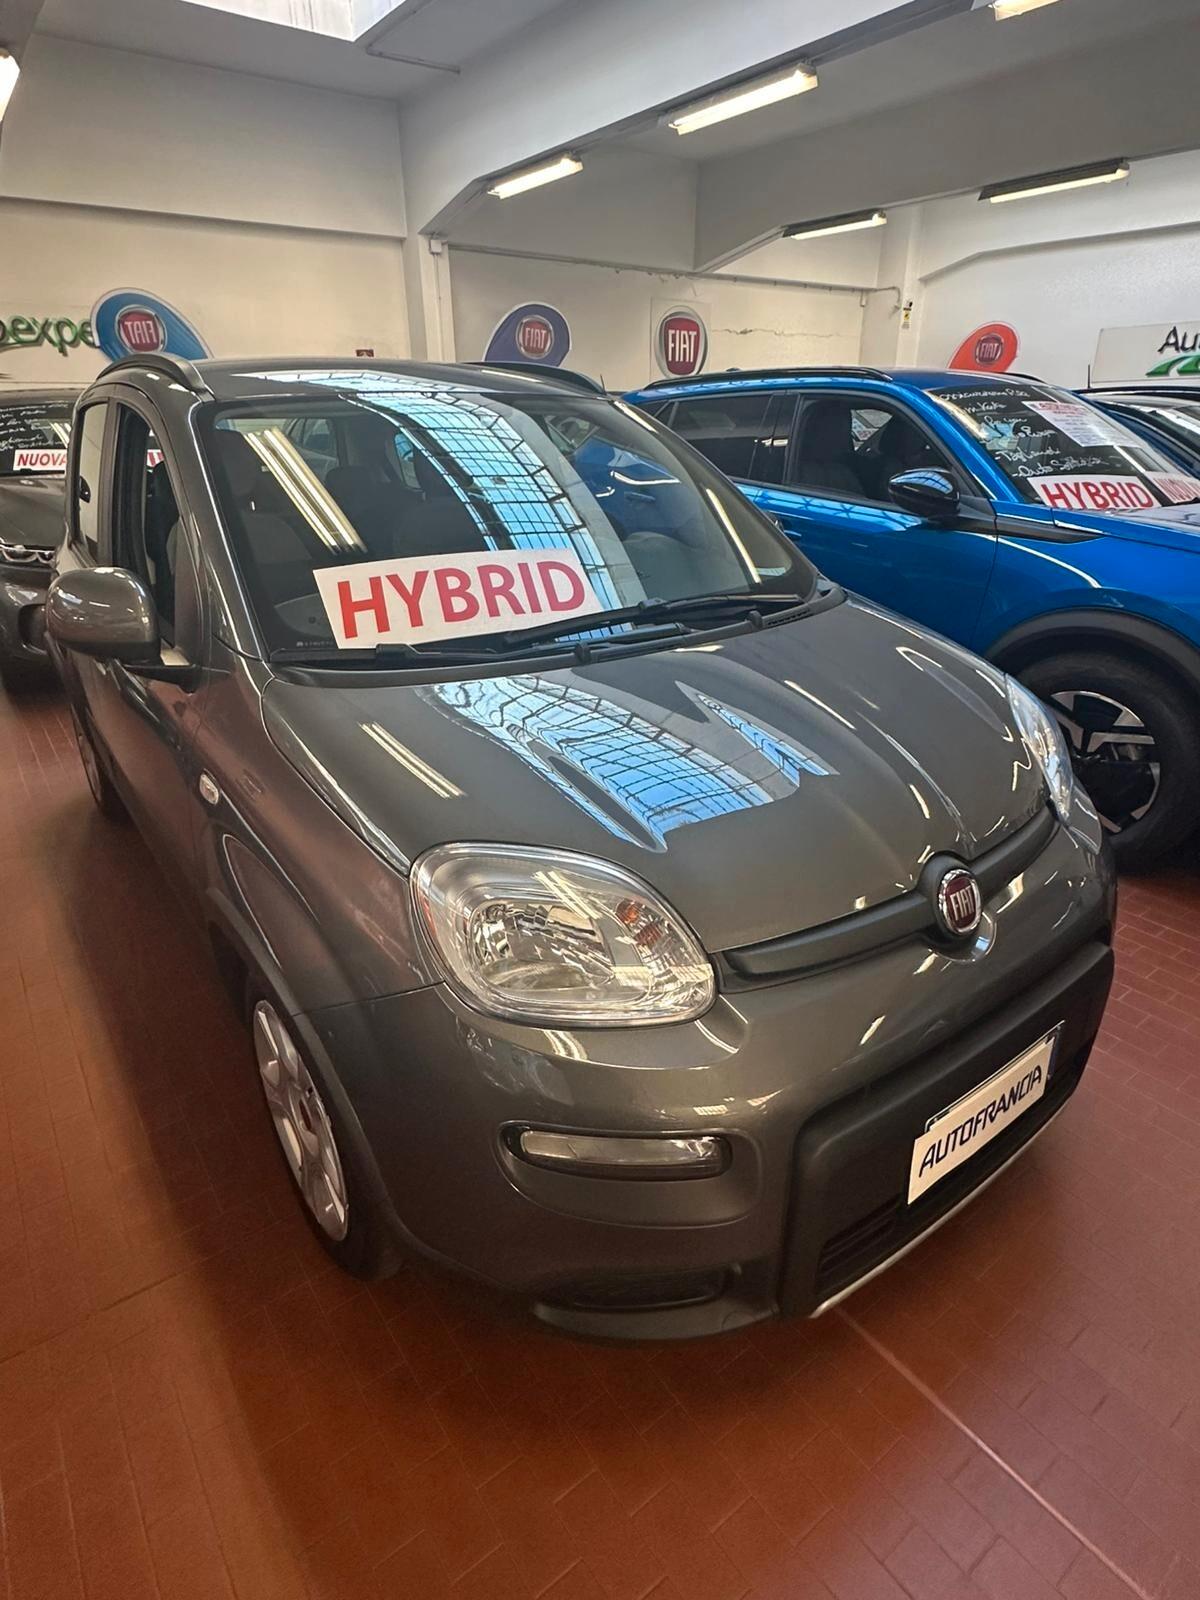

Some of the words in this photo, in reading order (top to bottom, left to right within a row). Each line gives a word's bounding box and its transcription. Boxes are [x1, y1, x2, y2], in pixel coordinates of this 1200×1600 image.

[525, 327, 547, 349] FIAT
[668, 329, 697, 362] FIAT
[980, 342, 1000, 358] FIAT
[1157, 325, 1200, 352] Au
[1041, 481, 1154, 509] HYBRID
[337, 560, 585, 639] HYBRID
[949, 885, 975, 920] FIAT
[919, 1064, 1042, 1178] AUTOFRANCIA
